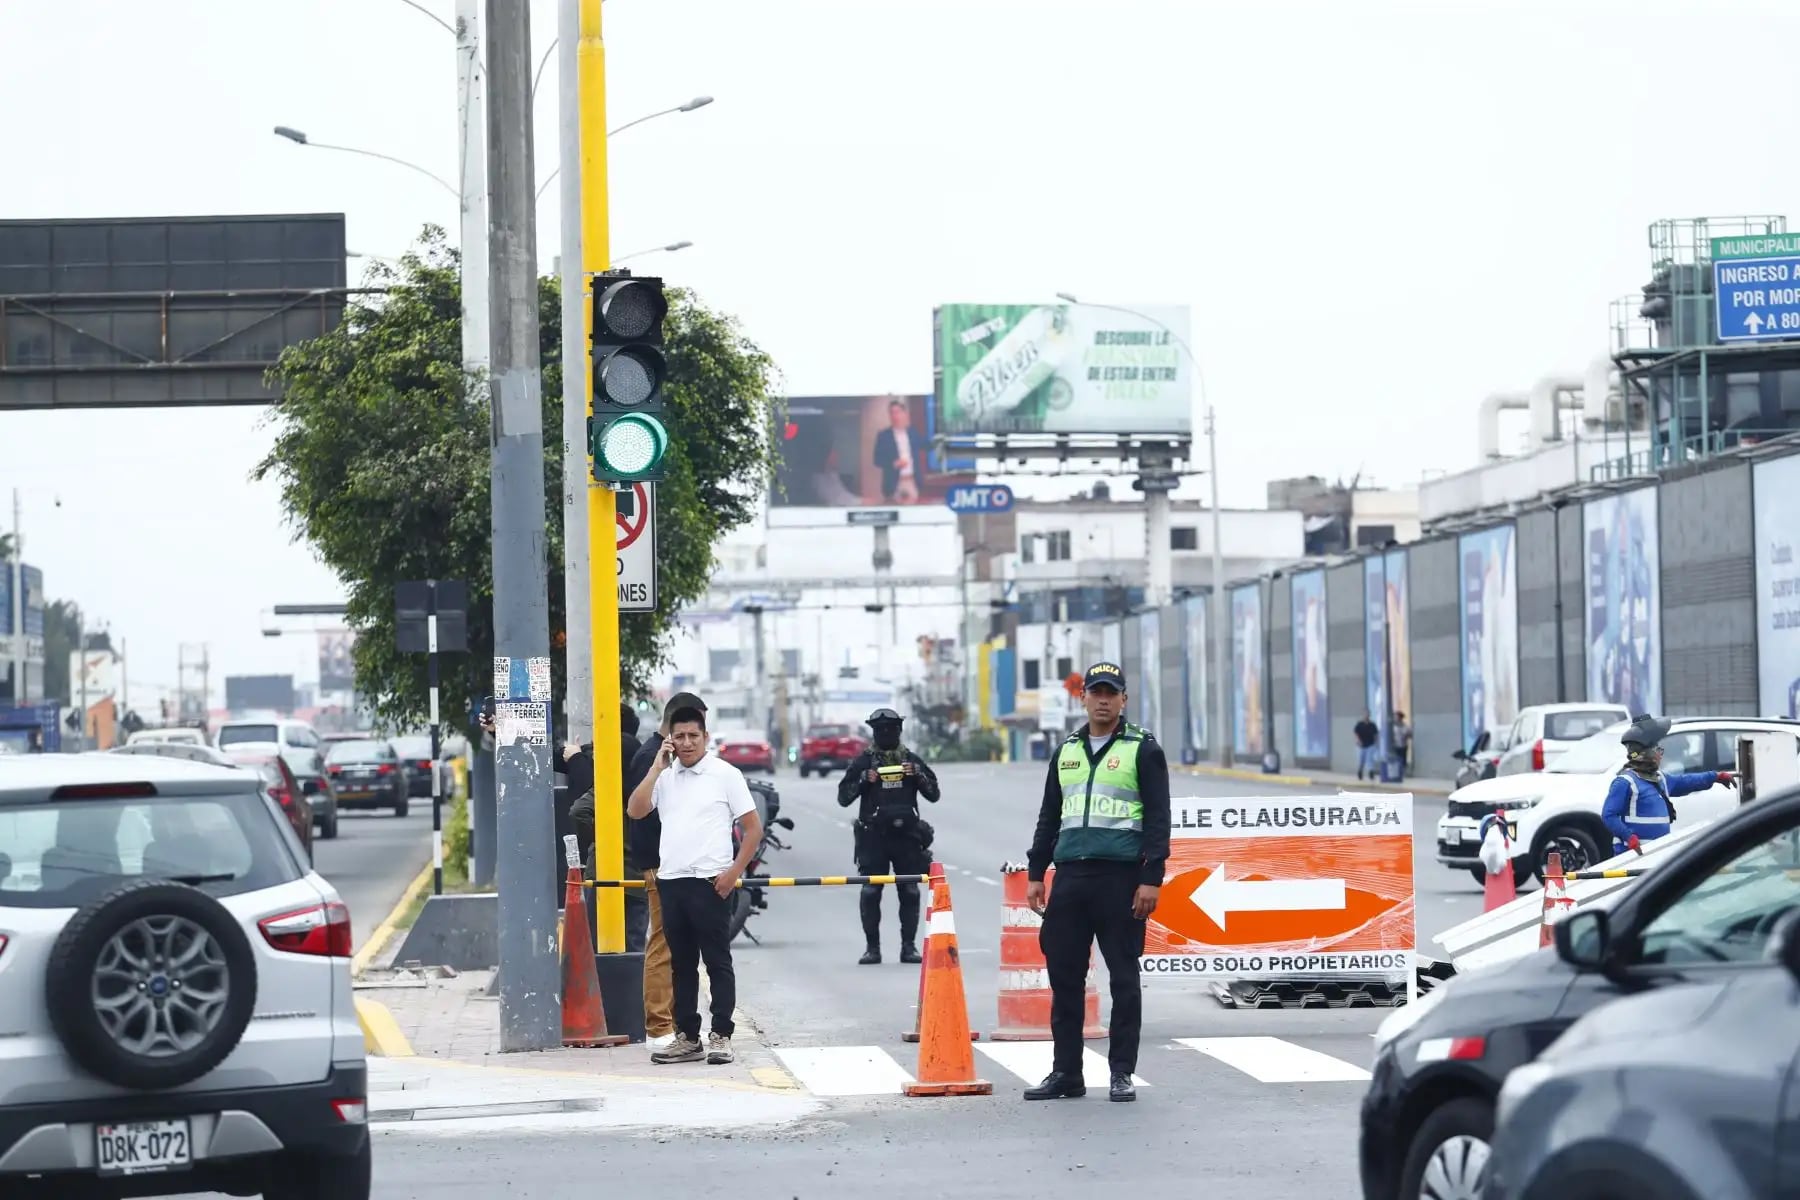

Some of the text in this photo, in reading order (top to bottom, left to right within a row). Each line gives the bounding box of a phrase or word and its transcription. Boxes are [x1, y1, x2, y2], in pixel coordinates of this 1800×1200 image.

[1721, 264, 1788, 284] INGRESO
[1733, 290, 1765, 307] POR
[1766, 313, 1777, 329] A
[618, 583, 647, 602] NES
[1090, 664, 1120, 676] POLICIA
[514, 709, 545, 719] TERRENO
[1063, 797, 1130, 816] OLICIA
[1221, 806, 1401, 829] CLAUSURADA
[1212, 957, 1263, 972] SOLO
[1269, 954, 1406, 971] PROPIETARIOS
[101, 1131, 187, 1164] D8K-072
